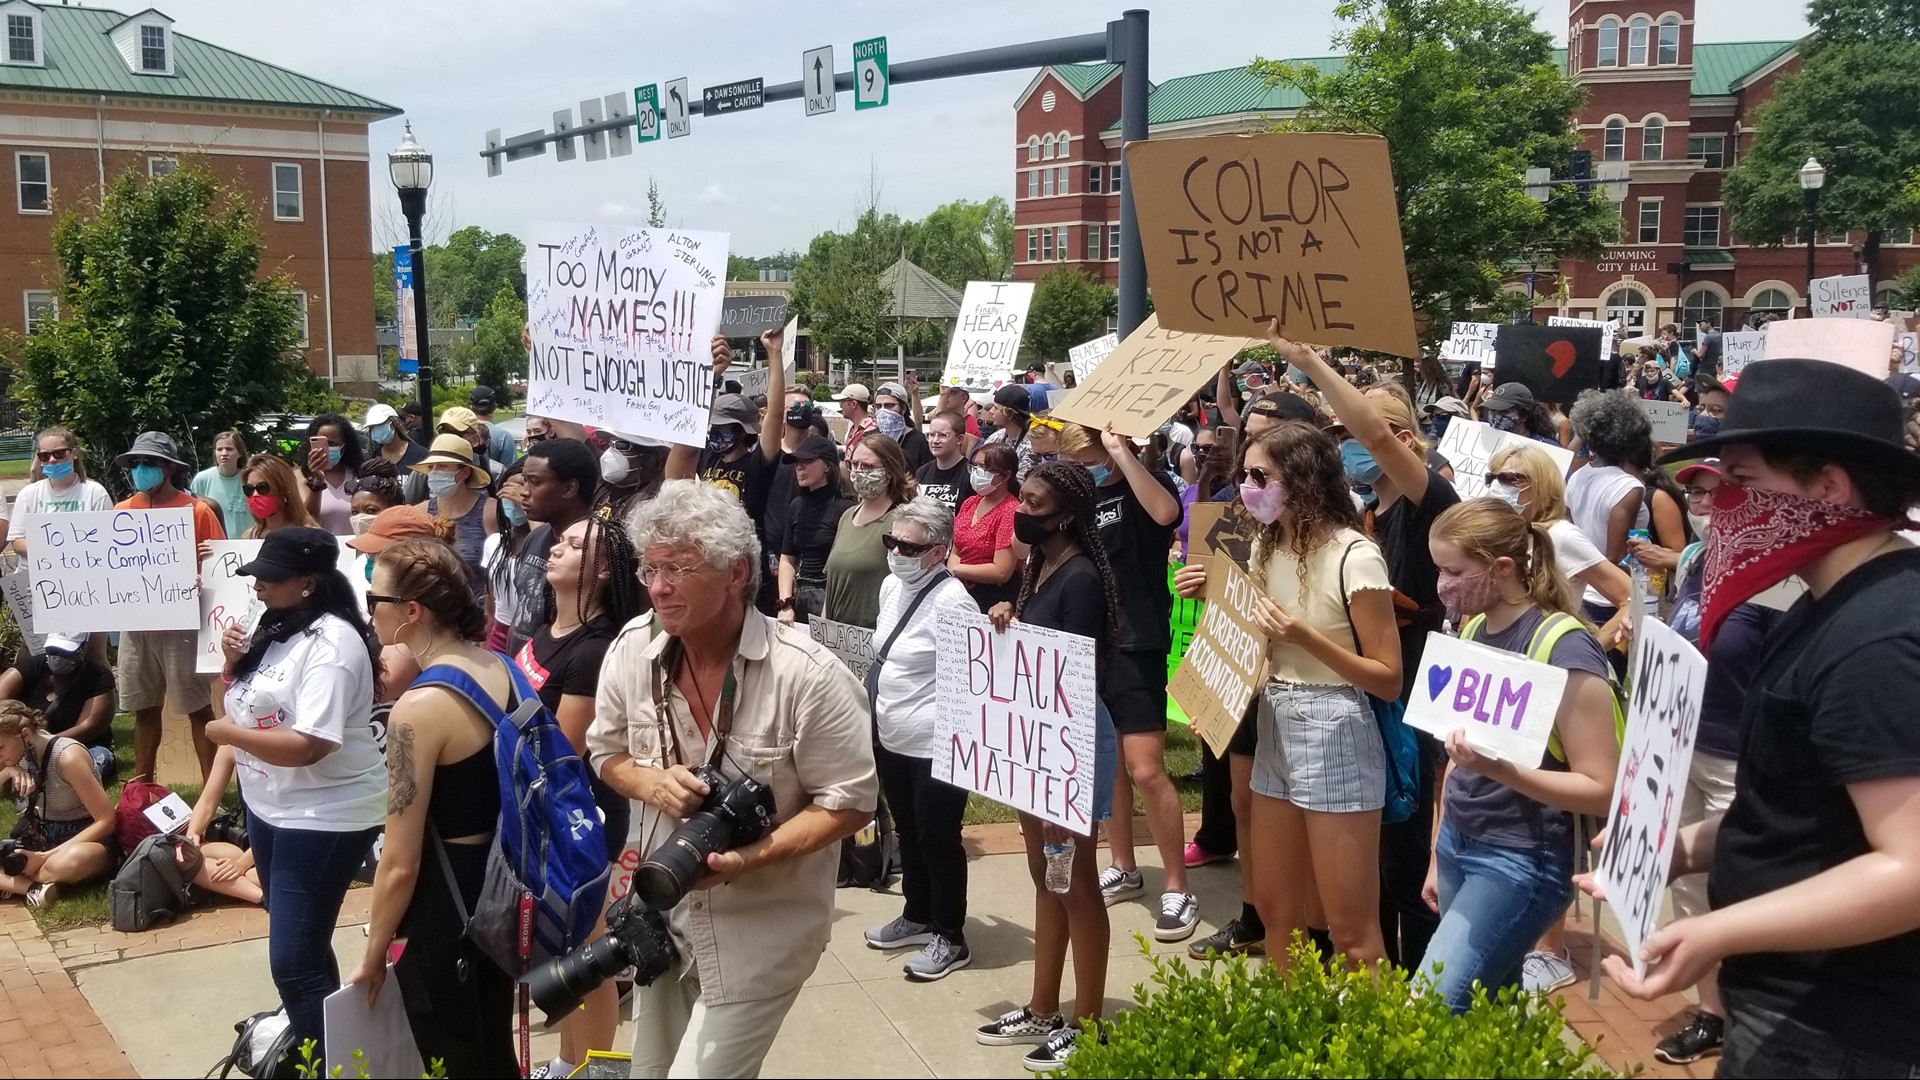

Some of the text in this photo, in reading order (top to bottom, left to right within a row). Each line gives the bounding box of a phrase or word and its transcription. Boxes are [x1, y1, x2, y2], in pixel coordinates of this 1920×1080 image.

[855, 40, 886, 58] NORTH
[638, 87, 655, 100] WEST
[714, 82, 761, 99] DAWSONVILLE
[864, 69, 874, 92] 9
[734, 96, 761, 108] CANTON
[809, 96, 832, 111] ONLY
[640, 110, 655, 130] 20
[670, 120, 686, 134] ONLY
[1183, 156, 1360, 250] COLOR
[619, 230, 649, 250] OSCAR
[668, 233, 702, 250] ALTON
[1169, 227, 1323, 266] IS NOT A
[673, 249, 716, 287] STERLING
[1597, 262, 1660, 272] CITY HALL
[1600, 251, 1656, 260] CUMMING
[596, 248, 666, 305] Many
[986, 284, 1008, 304] I
[1191, 270, 1354, 331] CRIME
[1818, 280, 1869, 302] Silence
[569, 289, 696, 339] NAMES!!!
[740, 304, 786, 324] JUSTICE
[1830, 300, 1856, 314] NOT
[963, 314, 1018, 334] HEAR
[1452, 322, 1479, 336] BLACK
[963, 338, 1016, 366] YOU!!
[1071, 335, 1117, 360] BLAME THE
[1726, 335, 1766, 350] HURT M
[1118, 348, 1215, 378] KILLS
[1727, 356, 1740, 366] Be
[533, 341, 714, 410] NOT ENOUGH JUSTICE
[1071, 381, 1186, 418] HATE!
[1444, 423, 1484, 460] ALL
[41, 512, 189, 546] To be Silent
[37, 546, 180, 571] is to be Complicit
[36, 574, 196, 610] Black Lives Matter
[1224, 566, 1258, 622] HOLD
[810, 618, 875, 661] BLACK
[1202, 599, 1260, 676] MURDERERS
[968, 626, 1074, 718] BLACK
[1184, 634, 1252, 723] ACCOUNTABLE
[1634, 638, 1664, 714] NO
[1453, 668, 1532, 730] BLM
[982, 702, 1078, 776] LIVES
[952, 732, 1087, 825] MATTER
[1602, 805, 1632, 886] NO
